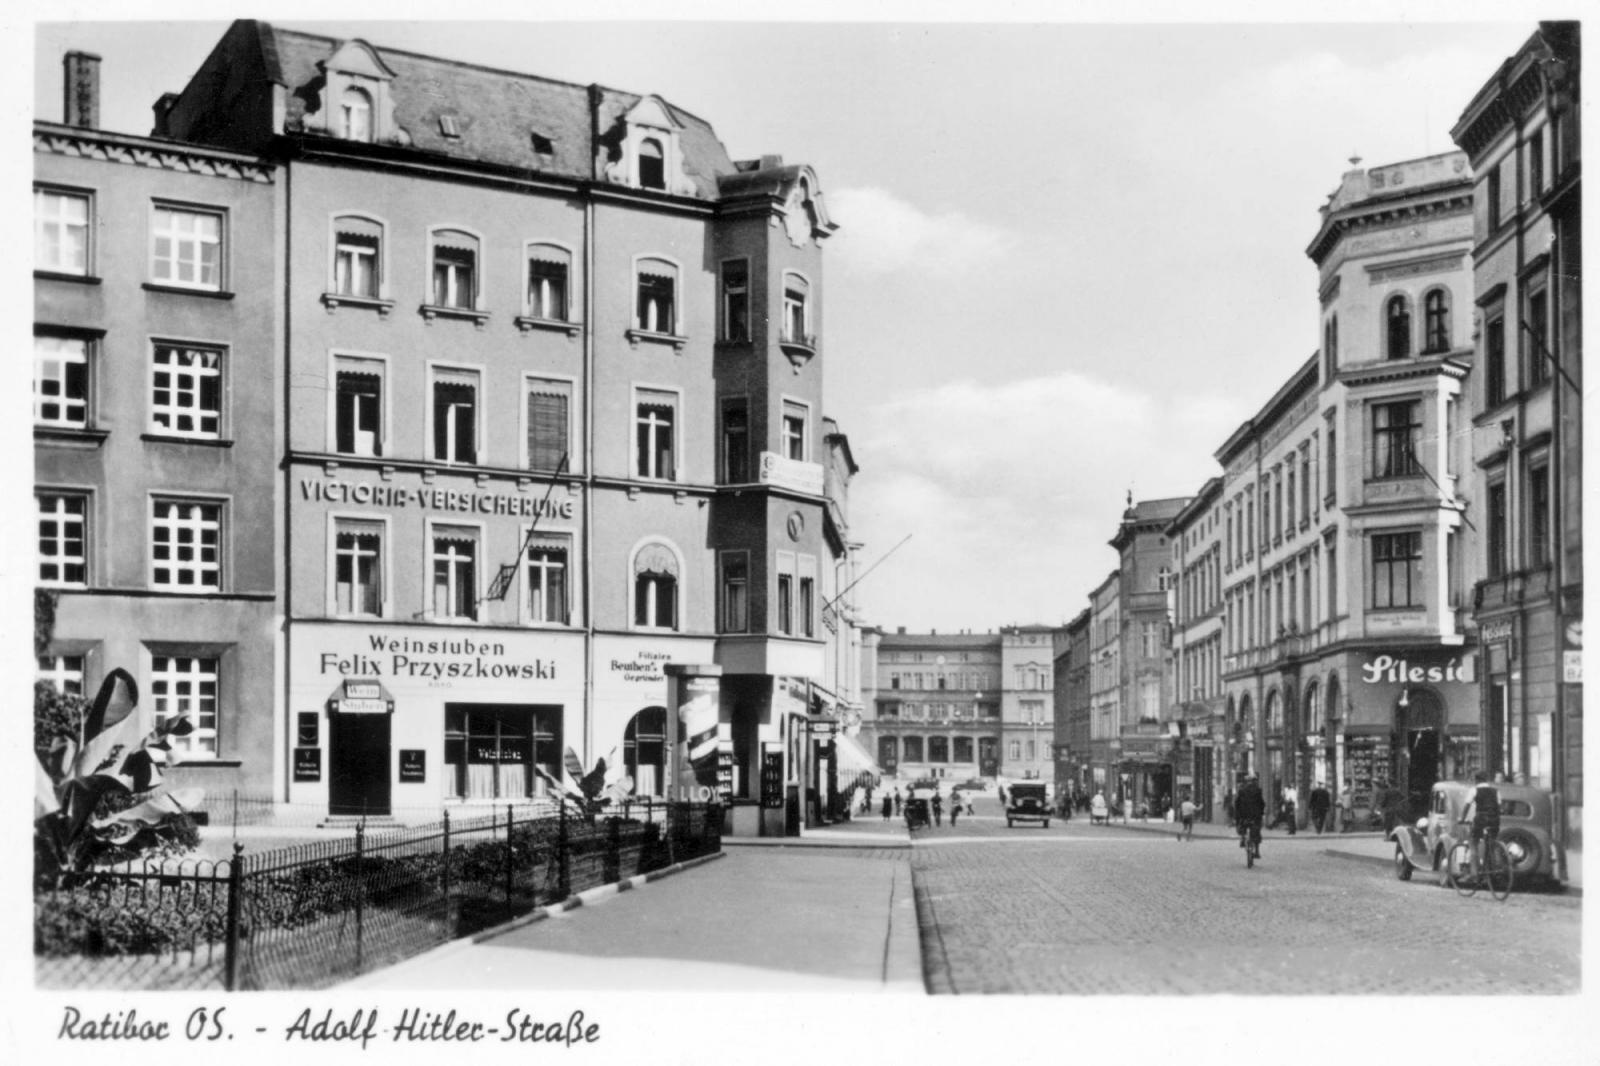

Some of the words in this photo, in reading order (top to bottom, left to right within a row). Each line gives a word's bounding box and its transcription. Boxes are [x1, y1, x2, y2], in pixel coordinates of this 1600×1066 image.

[369, 635, 505, 656] Weinstuben
[320, 653, 382, 676] Felix
[392, 655, 556, 680] Przyszkowski
